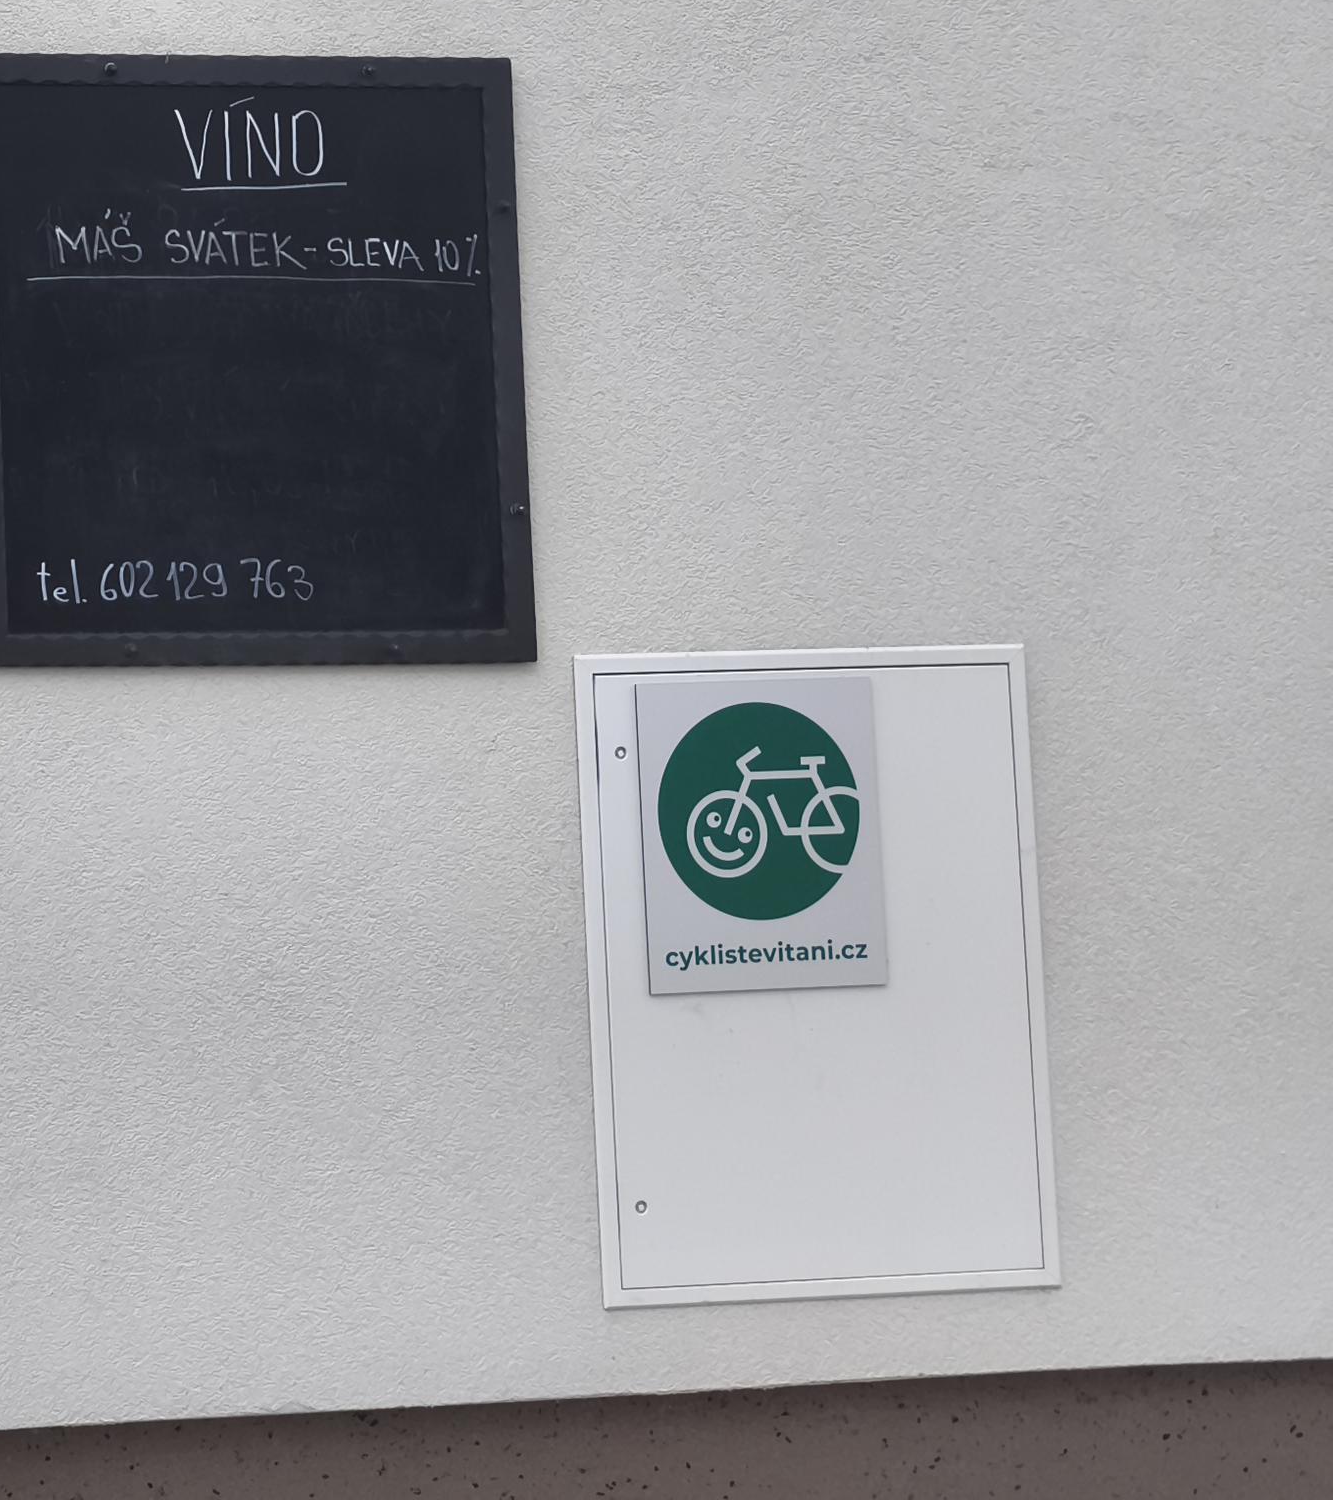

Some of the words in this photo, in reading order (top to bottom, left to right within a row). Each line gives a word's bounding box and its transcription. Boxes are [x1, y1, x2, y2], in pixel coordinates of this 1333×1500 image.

[173, 96, 325, 181] VÍNO
[55, 209, 143, 264] MÁŠ
[327, 237, 425, 272] SLEVA
[433, 233, 482, 277] 10%
[36, 558, 87, 603] tel.
[99, 560, 159, 601] 602
[166, 560, 228, 601] 129
[239, 557, 315, 601] 763
[665, 939, 869, 971] cyklistevitani.cz
